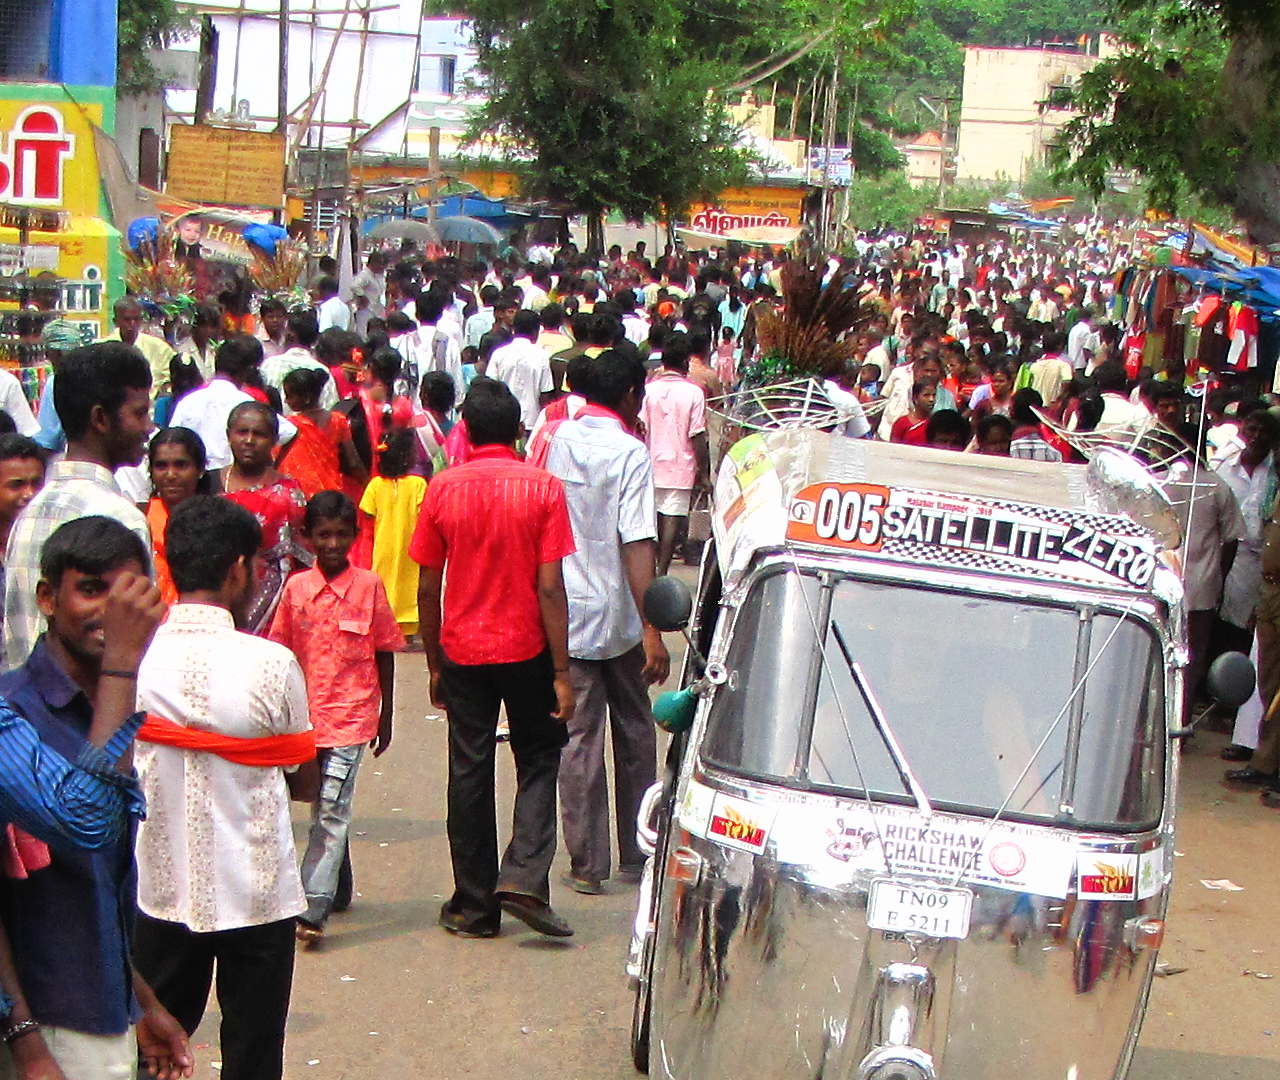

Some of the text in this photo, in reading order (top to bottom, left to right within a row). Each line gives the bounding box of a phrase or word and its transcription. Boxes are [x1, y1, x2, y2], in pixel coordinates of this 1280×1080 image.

[815, 487, 885, 546] 005
[882, 505, 1065, 563] SATELLITE
[885, 824, 982, 849] RICKSHAW
[883, 841, 983, 871] CHALLENGE
[897, 889, 949, 909] TN09
[887, 911, 950, 933] E 5211
